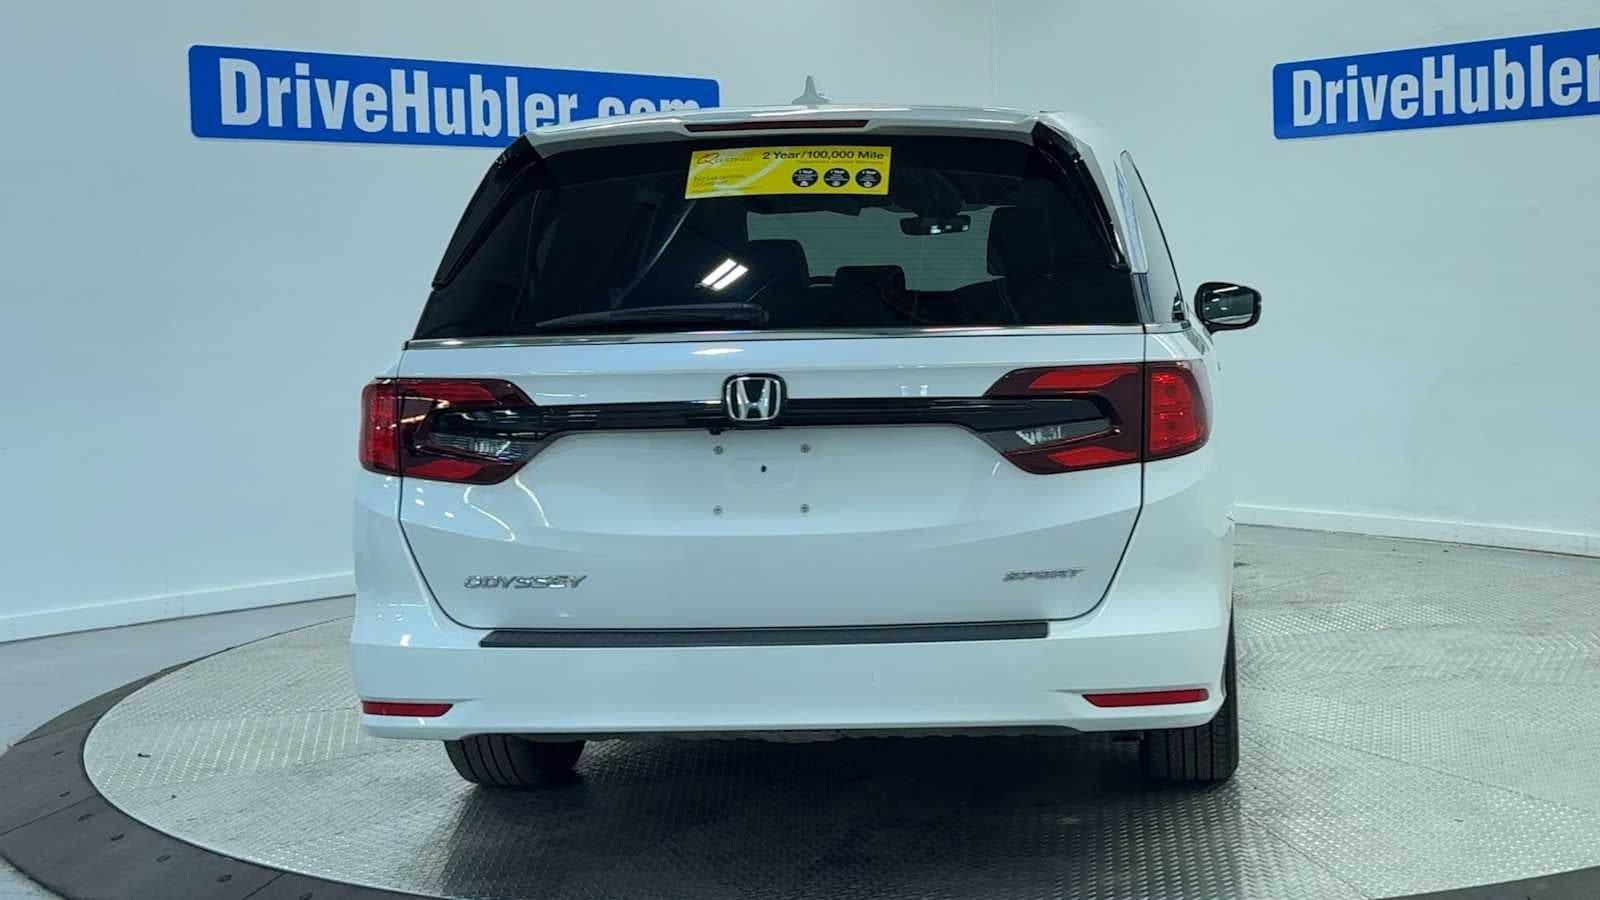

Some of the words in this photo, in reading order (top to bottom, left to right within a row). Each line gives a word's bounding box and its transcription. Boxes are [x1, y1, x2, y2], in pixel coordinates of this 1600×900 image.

[219, 57, 701, 137] DriveHublerc
[761, 151, 770, 160] 2
[773, 150, 854, 160] Year/100,000
[858, 151, 884, 160] Mile
[464, 575, 588, 589] ODYSSEY
[1002, 568, 1085, 582] SPORT
